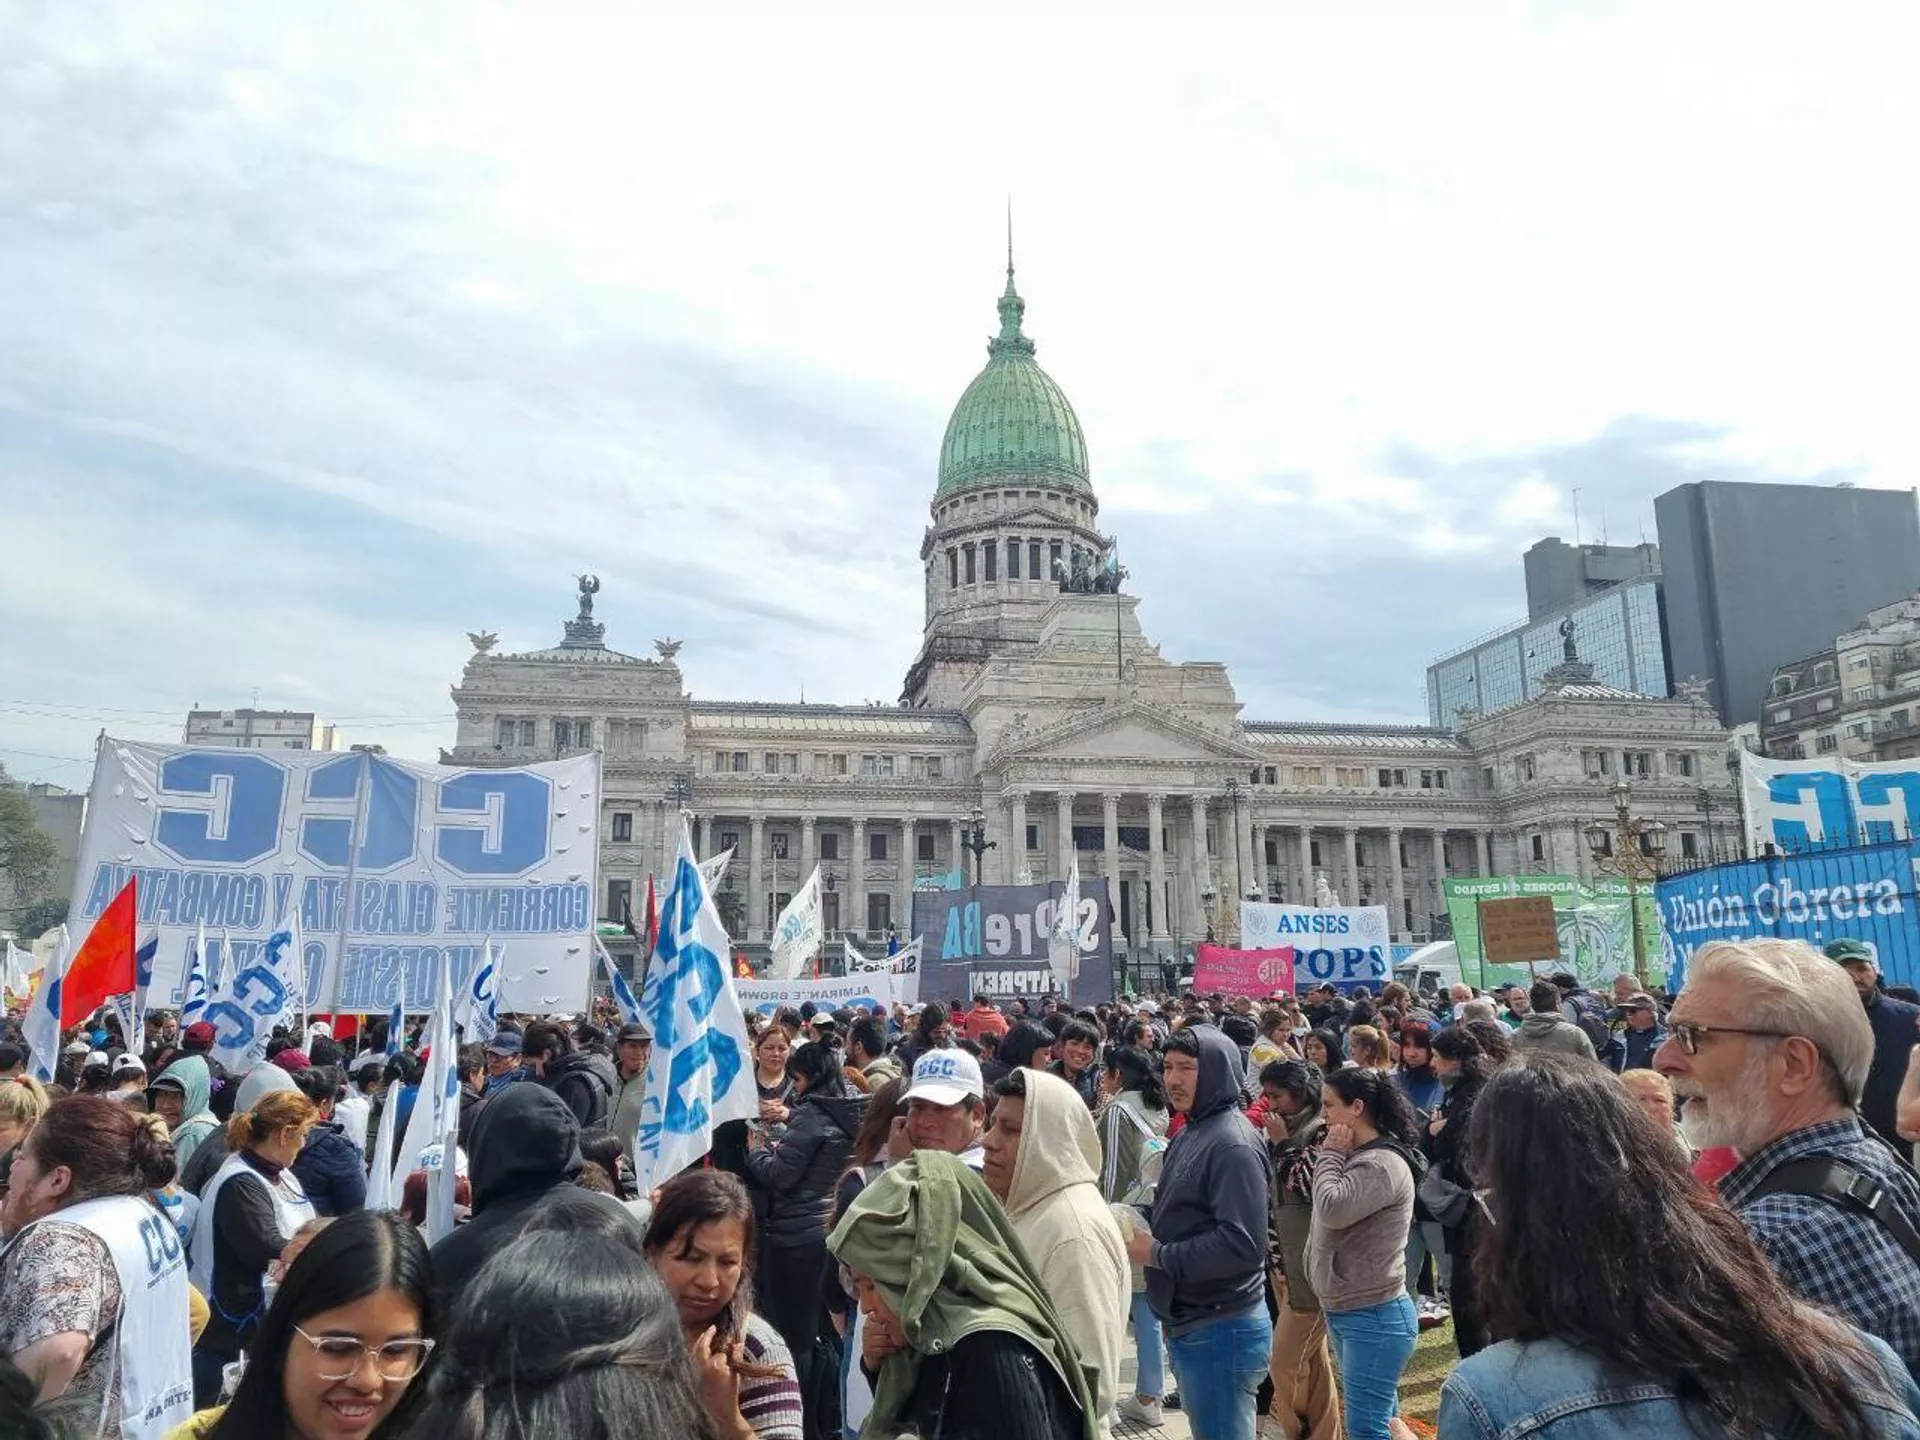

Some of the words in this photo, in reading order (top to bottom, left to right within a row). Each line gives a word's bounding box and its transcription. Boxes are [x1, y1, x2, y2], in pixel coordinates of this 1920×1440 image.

[1669, 884, 1749, 933] Unión
[1753, 878, 1904, 925] Obrera
[1277, 914, 1350, 934] ANSES
[1294, 945, 1386, 979] OPS
